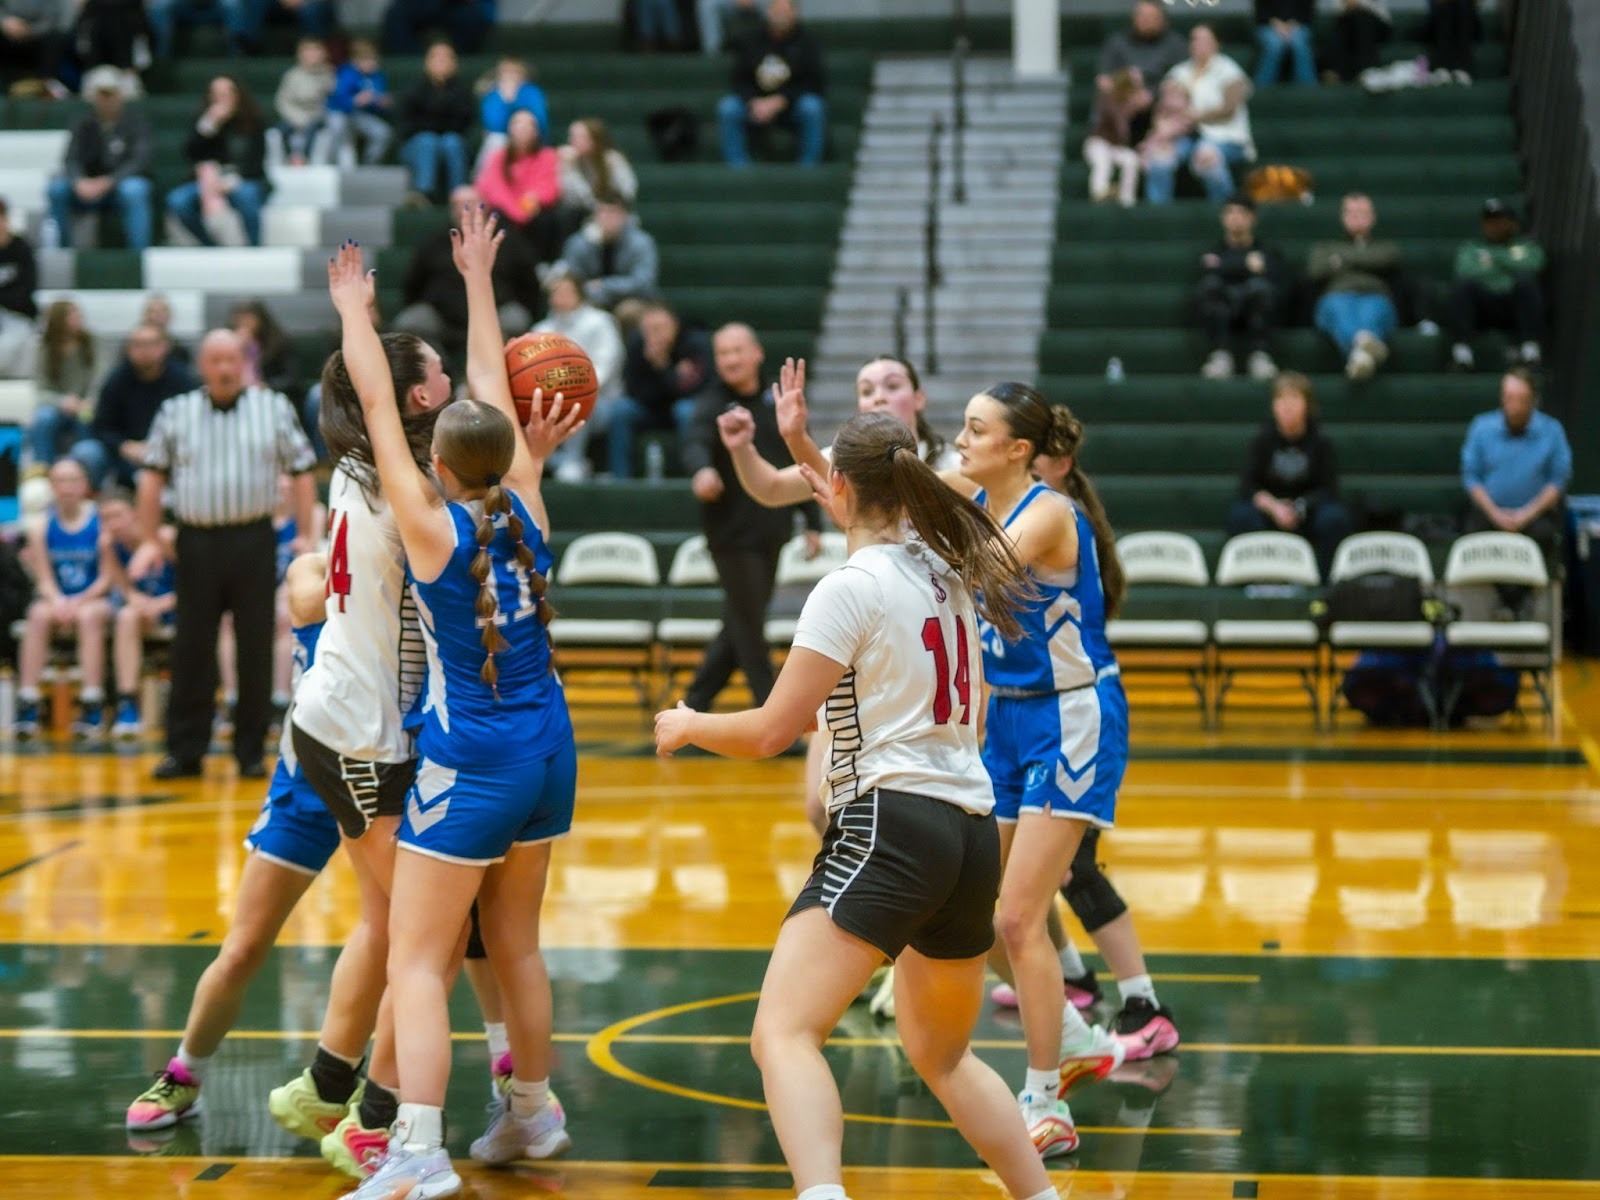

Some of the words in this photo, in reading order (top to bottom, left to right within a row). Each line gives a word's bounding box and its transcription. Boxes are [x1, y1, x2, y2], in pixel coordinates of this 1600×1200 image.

[534, 366, 591, 383] LEGACY
[325, 508, 352, 614] 4
[921, 615, 970, 725] 14
